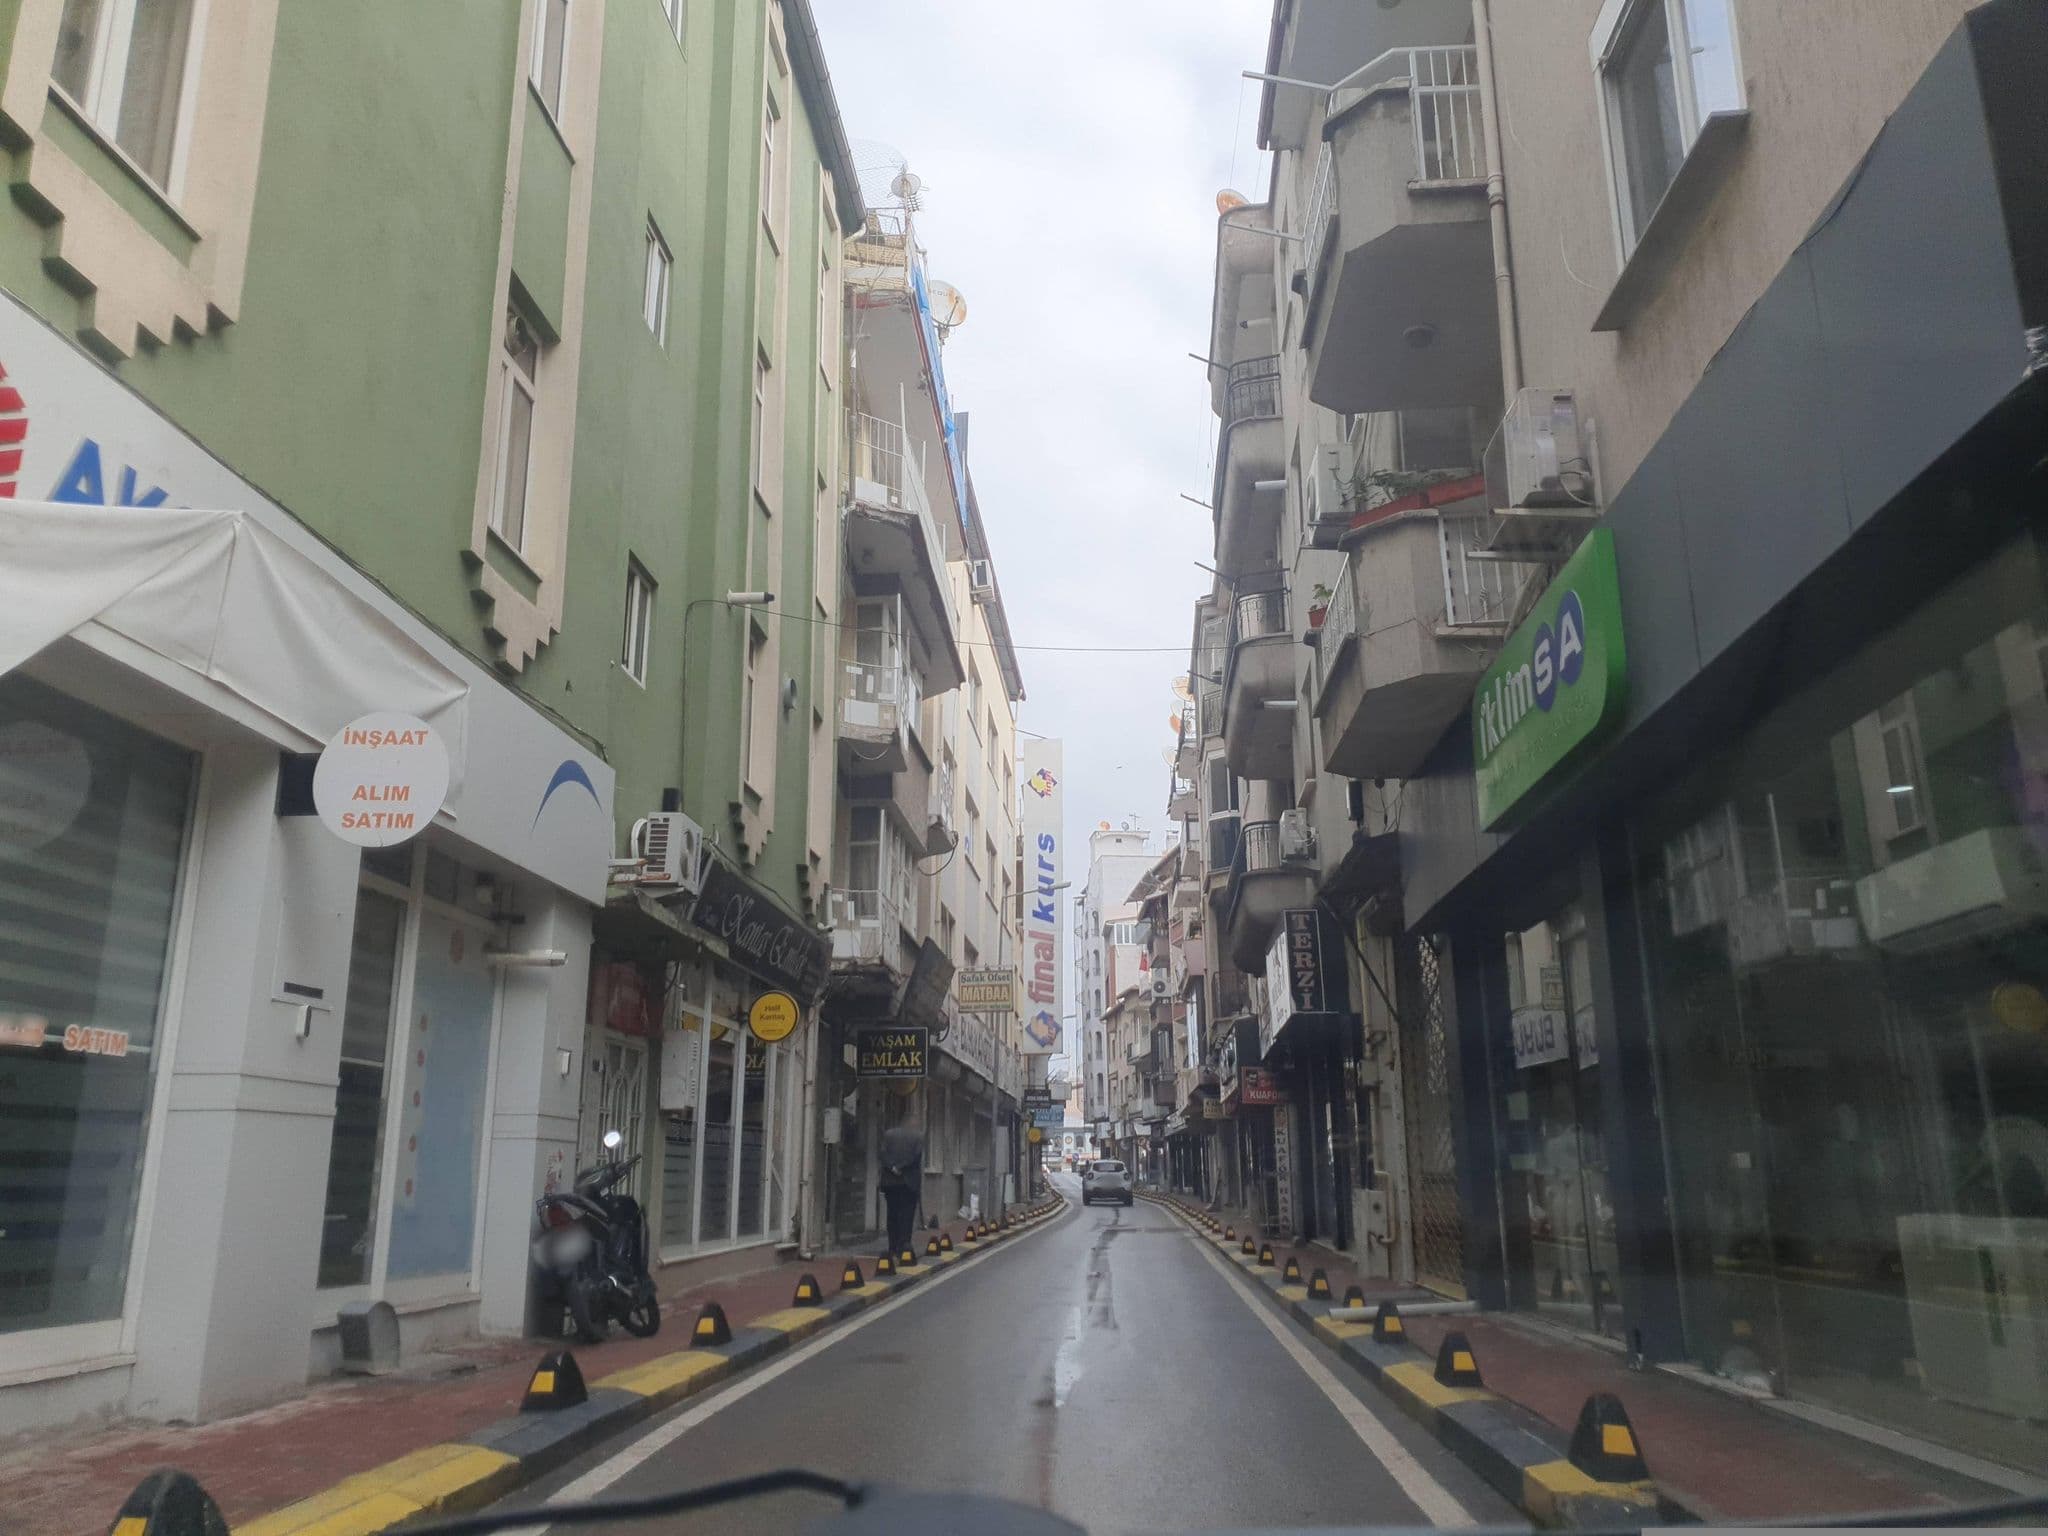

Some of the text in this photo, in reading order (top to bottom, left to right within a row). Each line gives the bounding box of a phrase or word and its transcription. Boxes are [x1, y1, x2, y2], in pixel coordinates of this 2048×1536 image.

[343, 726, 429, 748] İNŞAAT
[351, 784, 410, 802] ALIM
[341, 812, 415, 829] SATIM
[1032, 833, 1055, 924] kurs
[1028, 930, 1055, 1006] final
[987, 972, 1010, 982] Ofset
[962, 985, 1009, 1001] MATBAA
[64, 1024, 128, 1056] SATIM
[868, 1034, 917, 1050] YAŞAM
[861, 1051, 922, 1067] EMLAK
